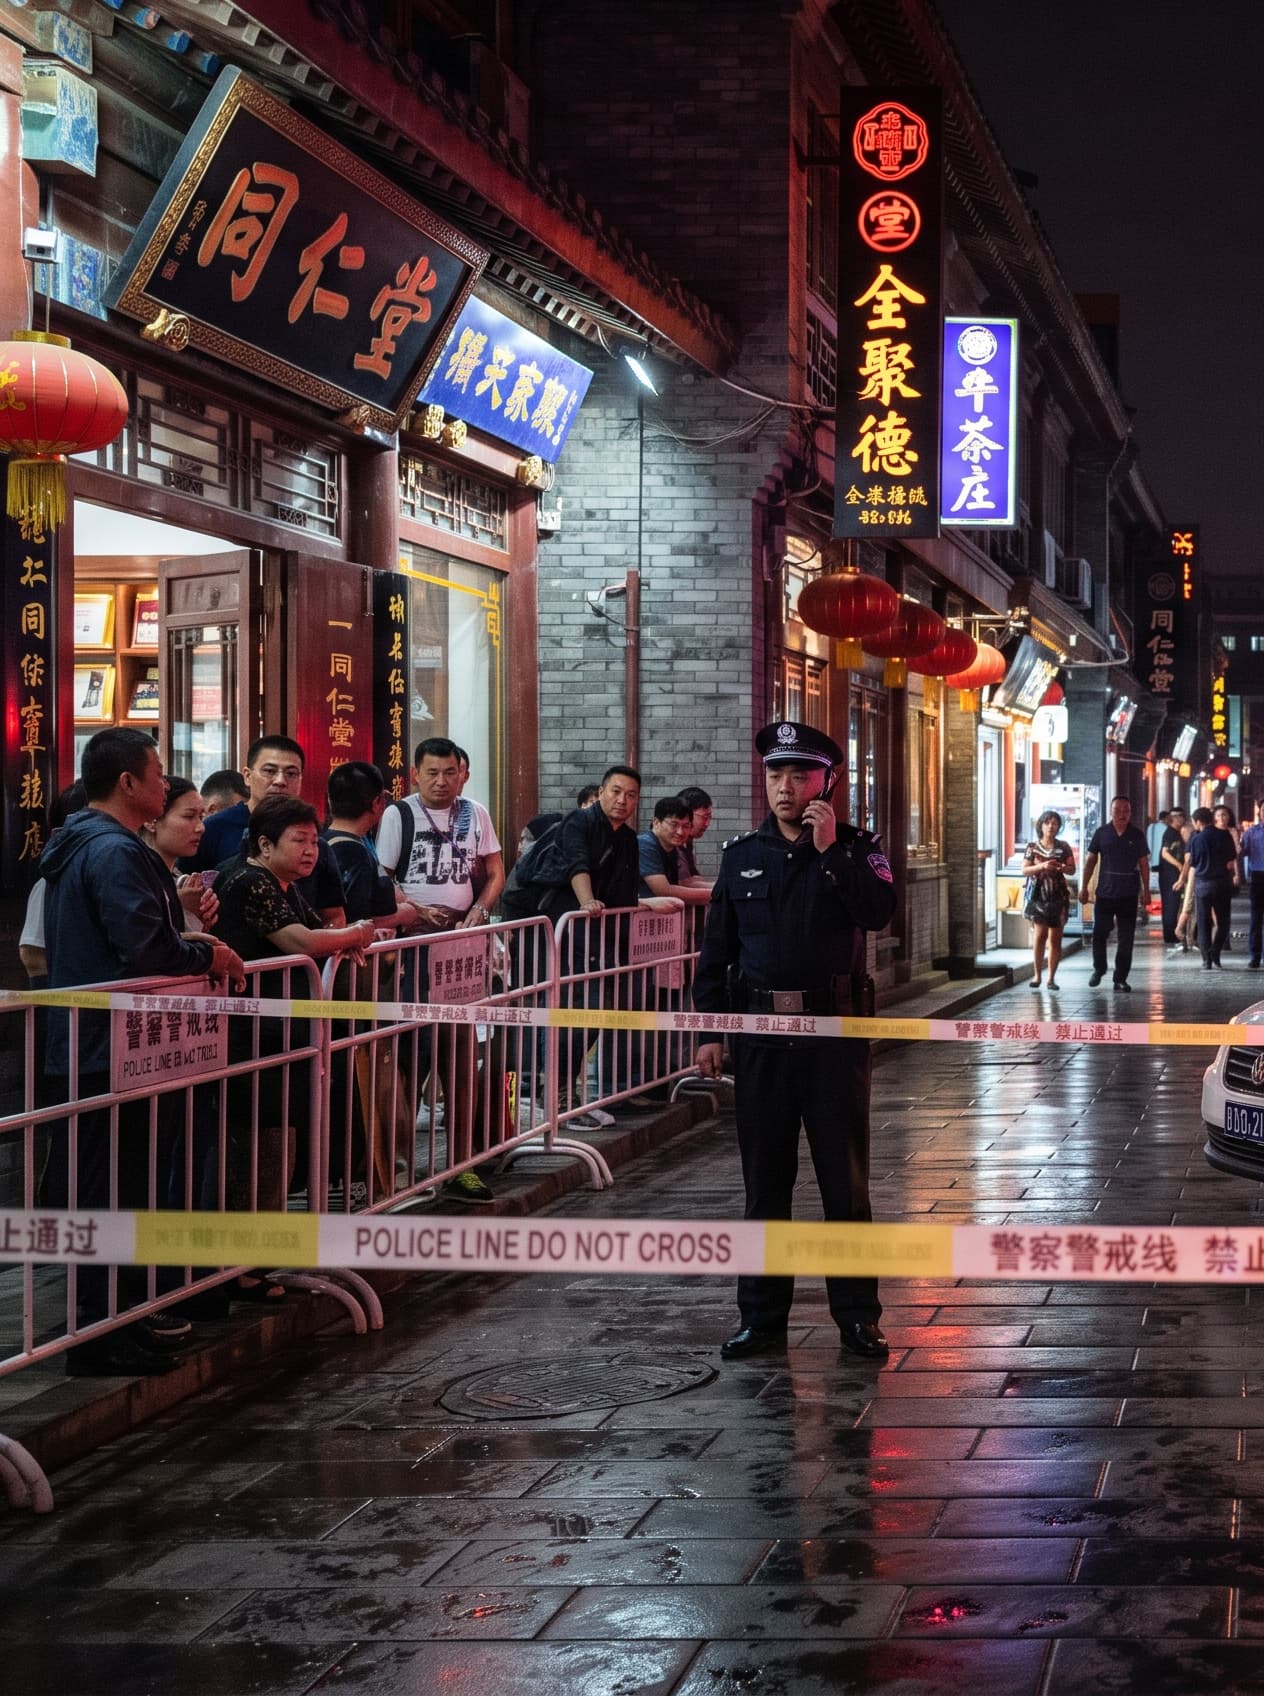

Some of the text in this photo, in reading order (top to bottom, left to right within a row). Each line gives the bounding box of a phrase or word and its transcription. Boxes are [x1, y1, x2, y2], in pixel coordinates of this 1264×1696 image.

[869, 199, 910, 241] 堂
[198, 162, 437, 381] 同仁堂
[852, 264, 926, 475] 全聚德
[356, 1227, 732, 1264] POLICE LINE DO NOT CROSS
[990, 1232, 1178, 1273] 警察警戒线
